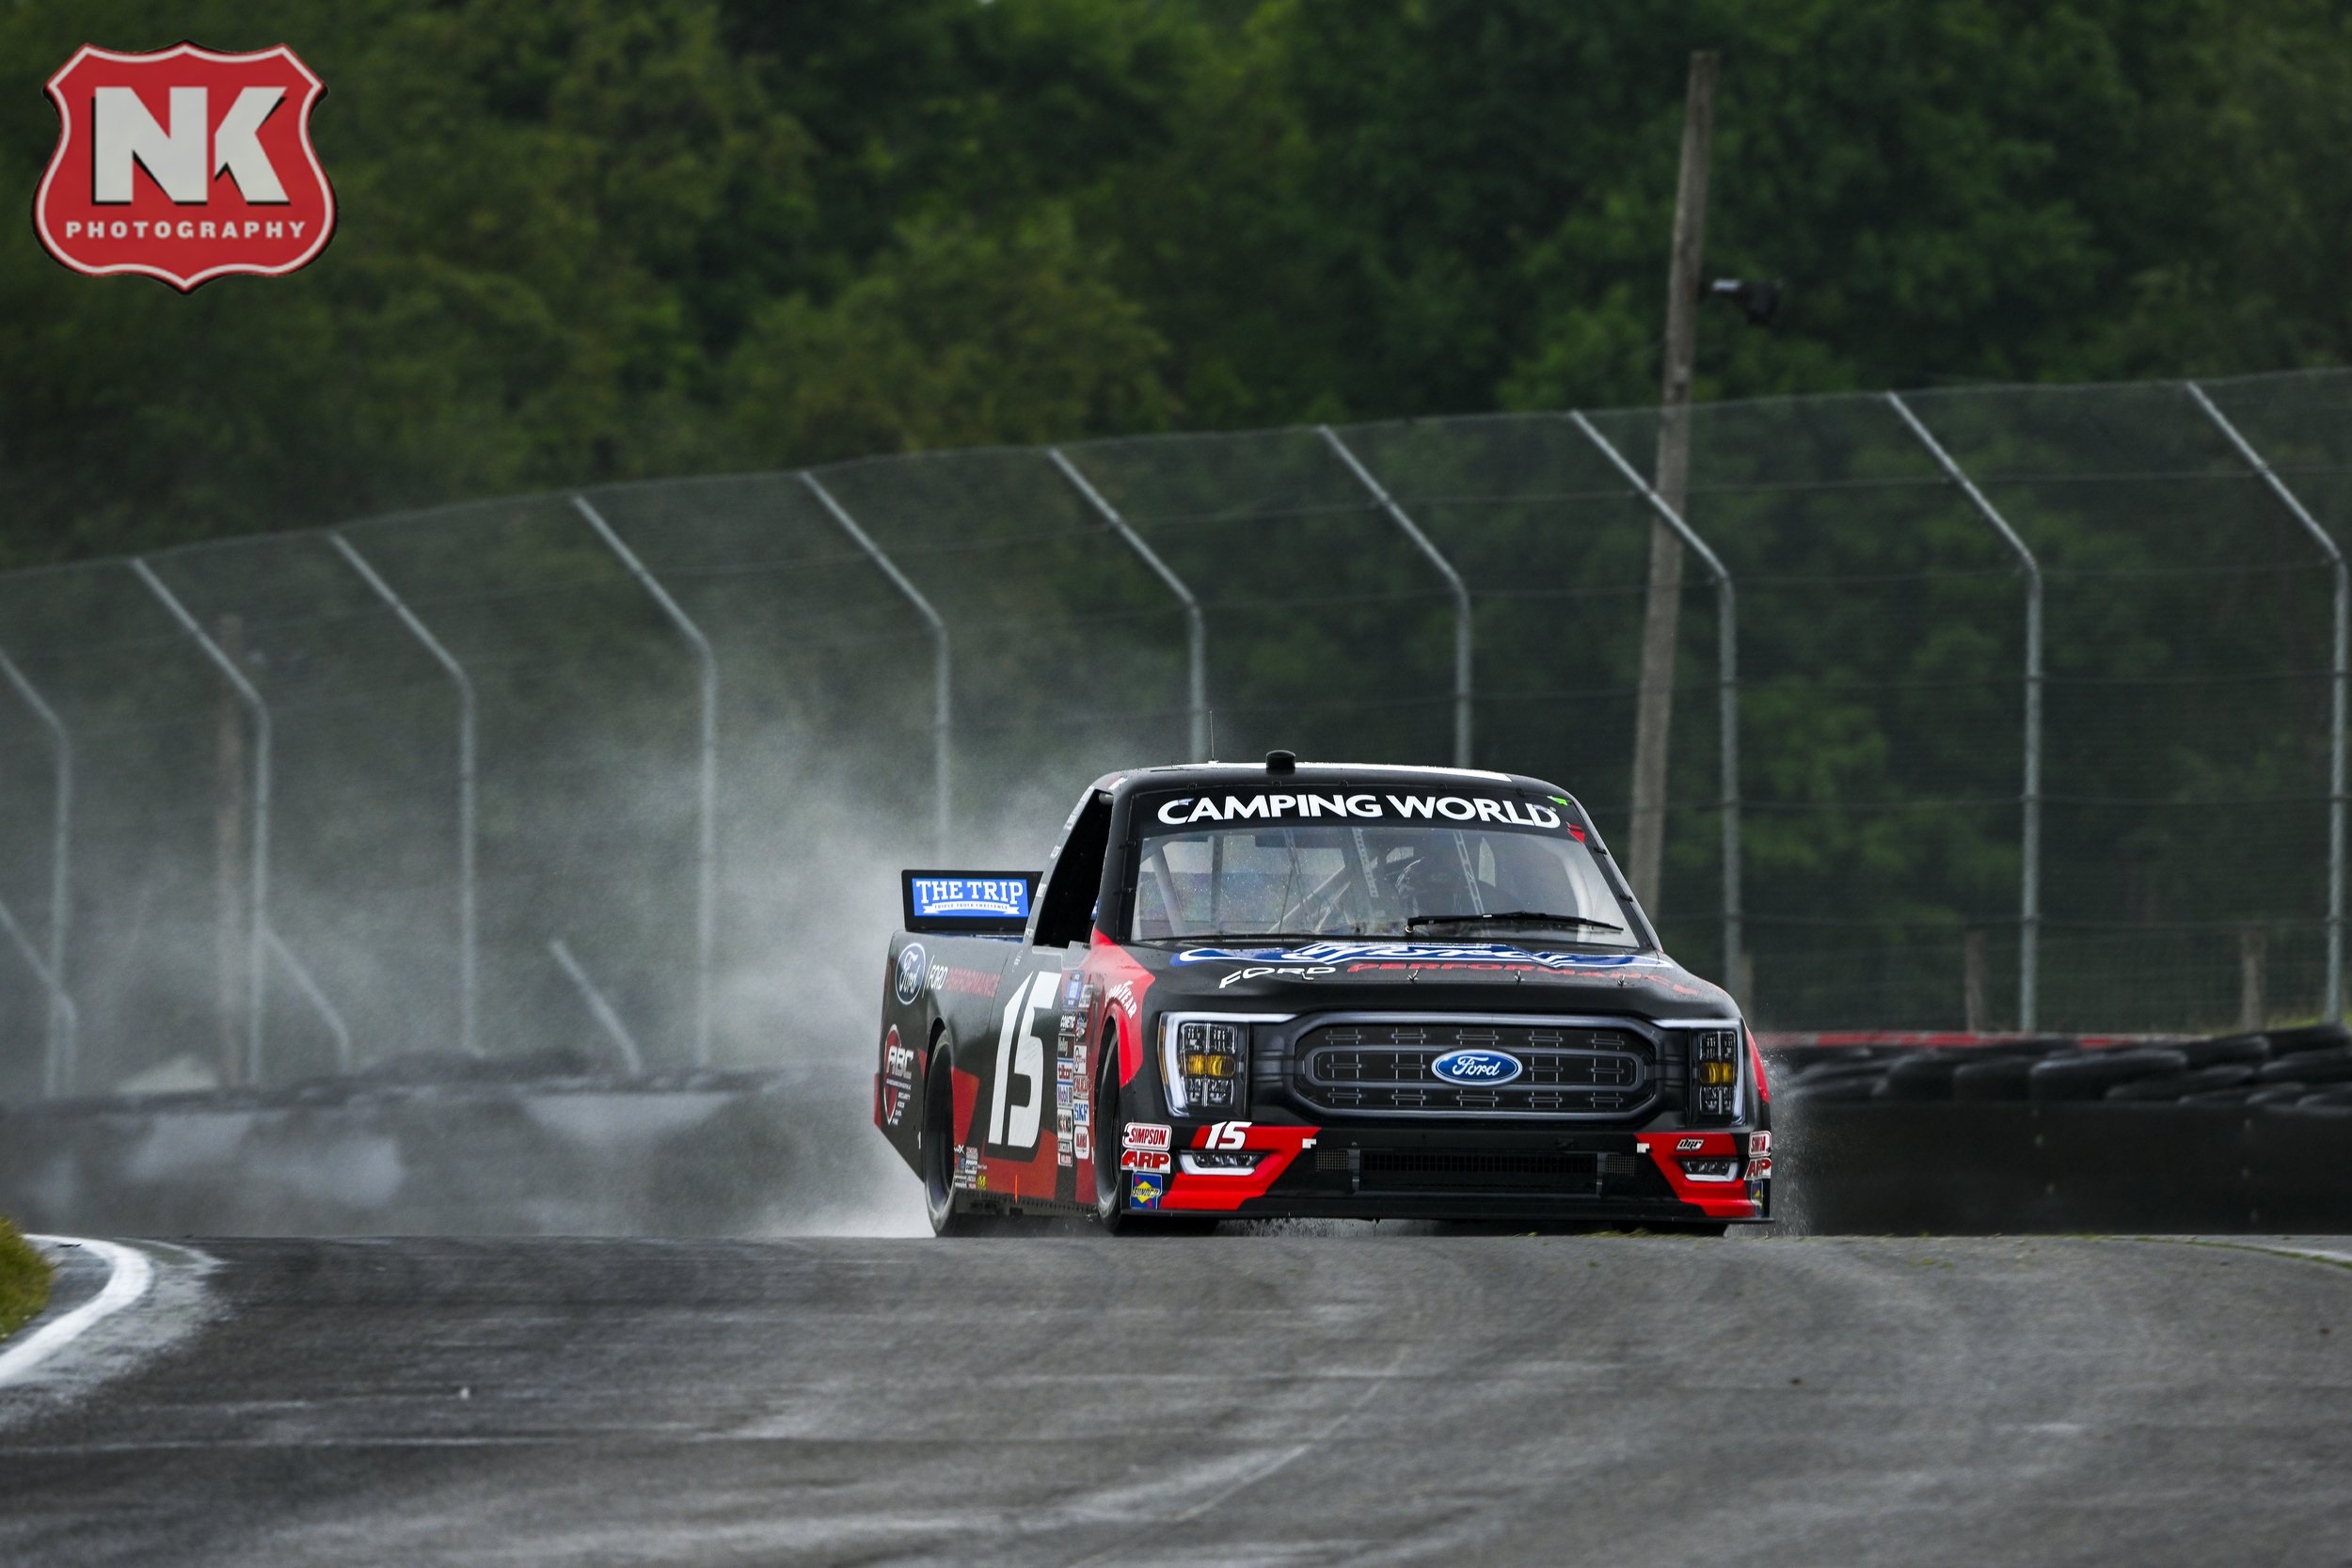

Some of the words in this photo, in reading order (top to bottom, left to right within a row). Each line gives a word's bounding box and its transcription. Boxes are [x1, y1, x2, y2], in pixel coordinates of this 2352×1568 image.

[1157, 794, 1383, 825] CAMPING
[1386, 795, 1561, 829] WORLD
[915, 880, 963, 904] THE
[966, 881, 1024, 905] TRIP
[898, 950, 921, 994] Ford
[927, 965, 948, 990] FORD
[1218, 967, 1336, 989] FORD
[886, 1045, 914, 1080] ABC
[988, 971, 1062, 1148] 15
[1452, 1055, 1502, 1076] Ford
[1074, 1103, 1089, 1121] SKF
[1128, 1127, 1167, 1146] SIMPSON
[1205, 1120, 1252, 1150] 15
[1121, 1150, 1169, 1169] ARP
